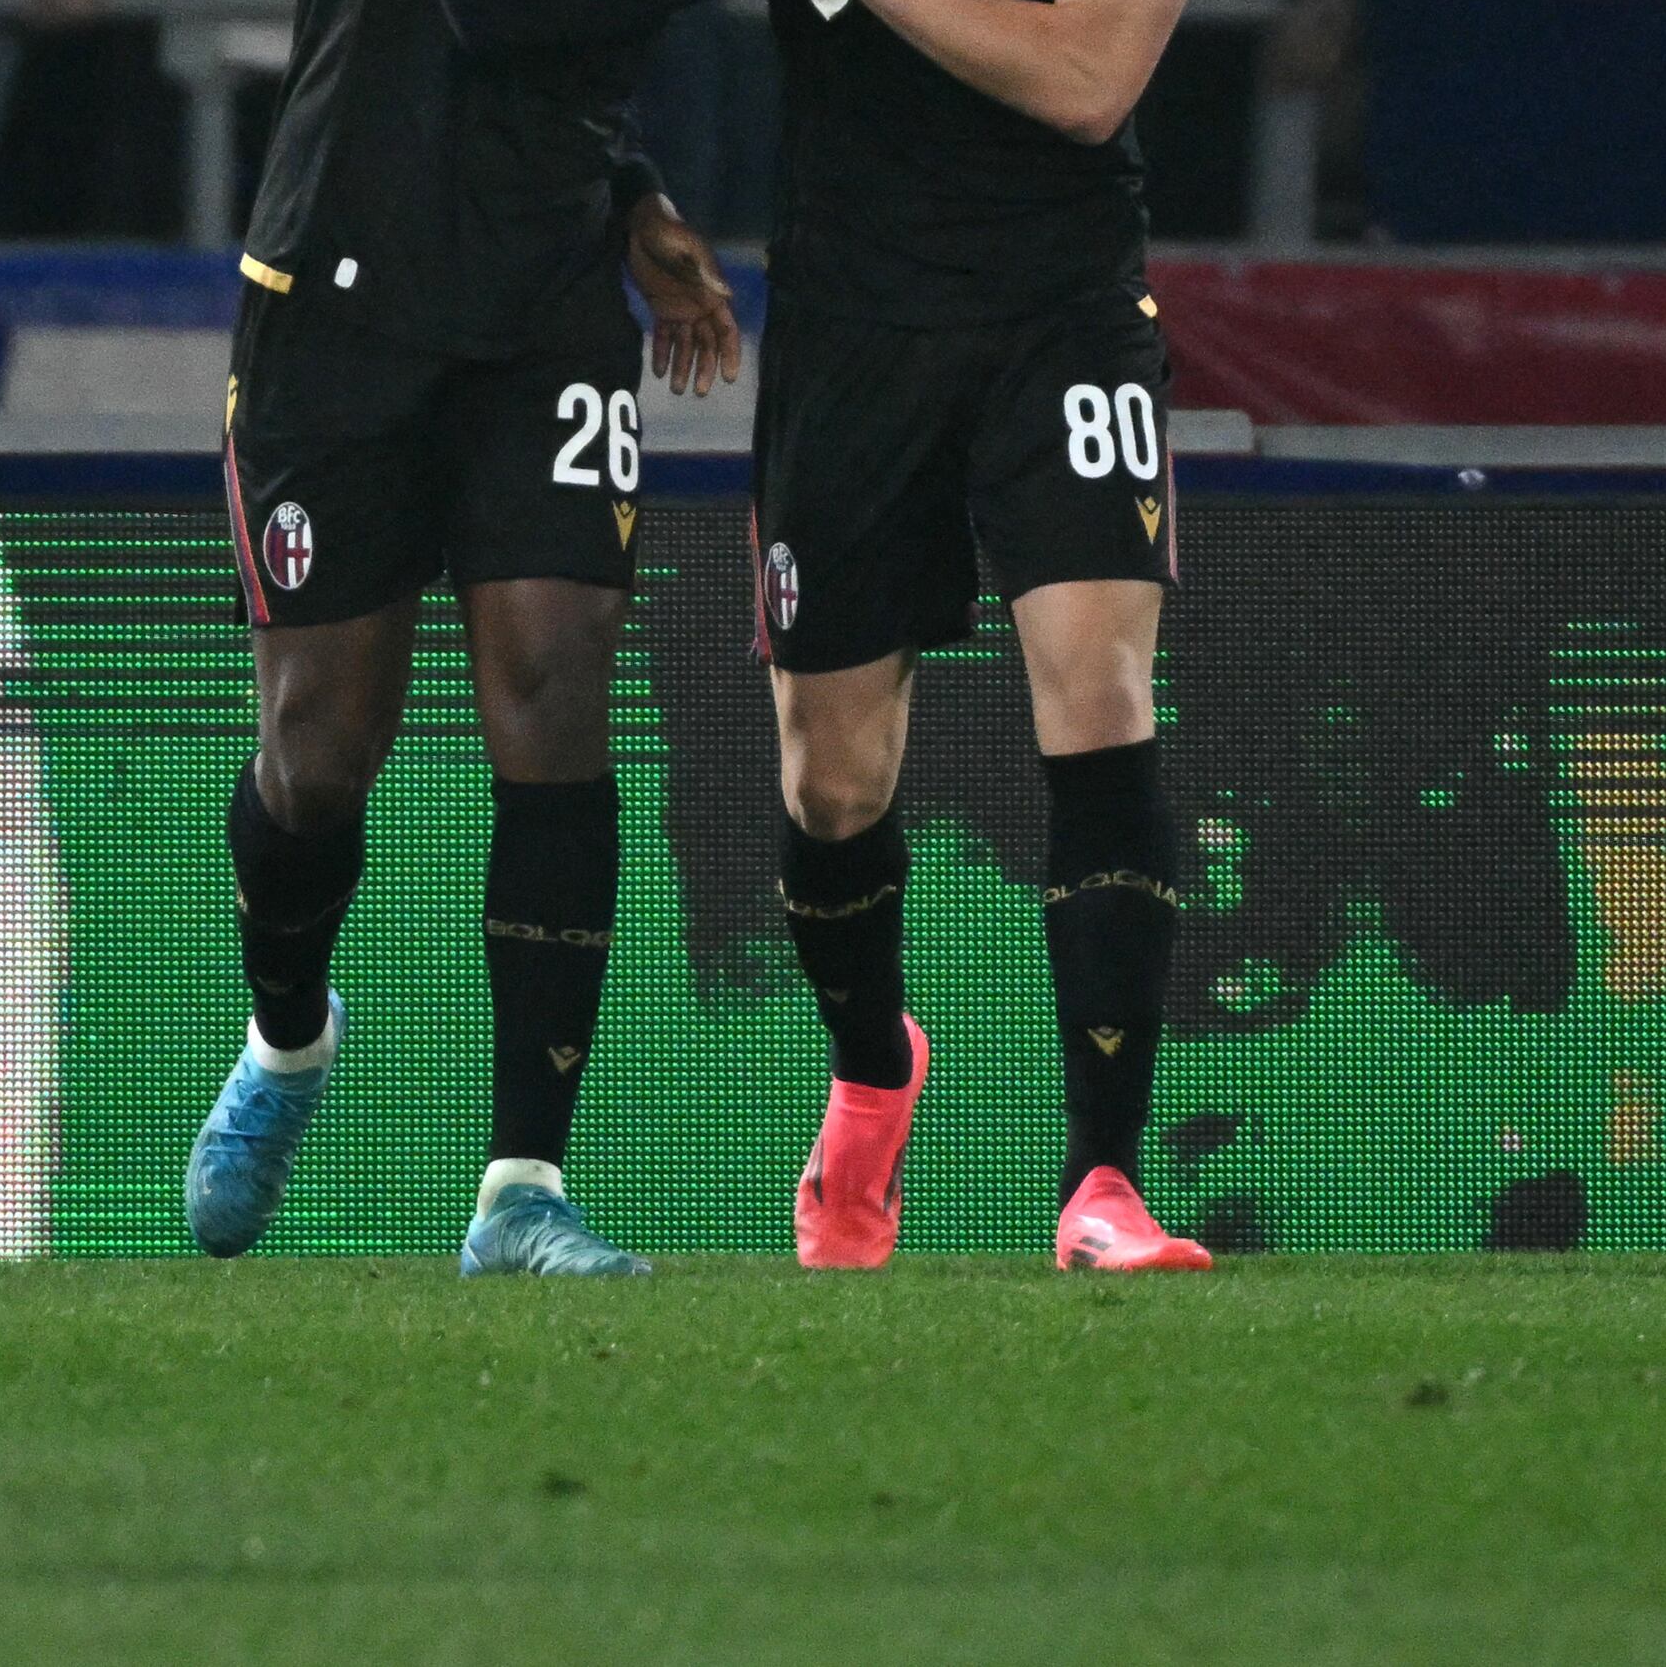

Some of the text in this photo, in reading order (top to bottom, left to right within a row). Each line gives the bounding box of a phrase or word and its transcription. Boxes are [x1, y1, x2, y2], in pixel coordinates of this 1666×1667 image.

[551, 382, 640, 493] 26
[1064, 382, 1160, 480] 80
[278, 505, 301, 523] BFC
